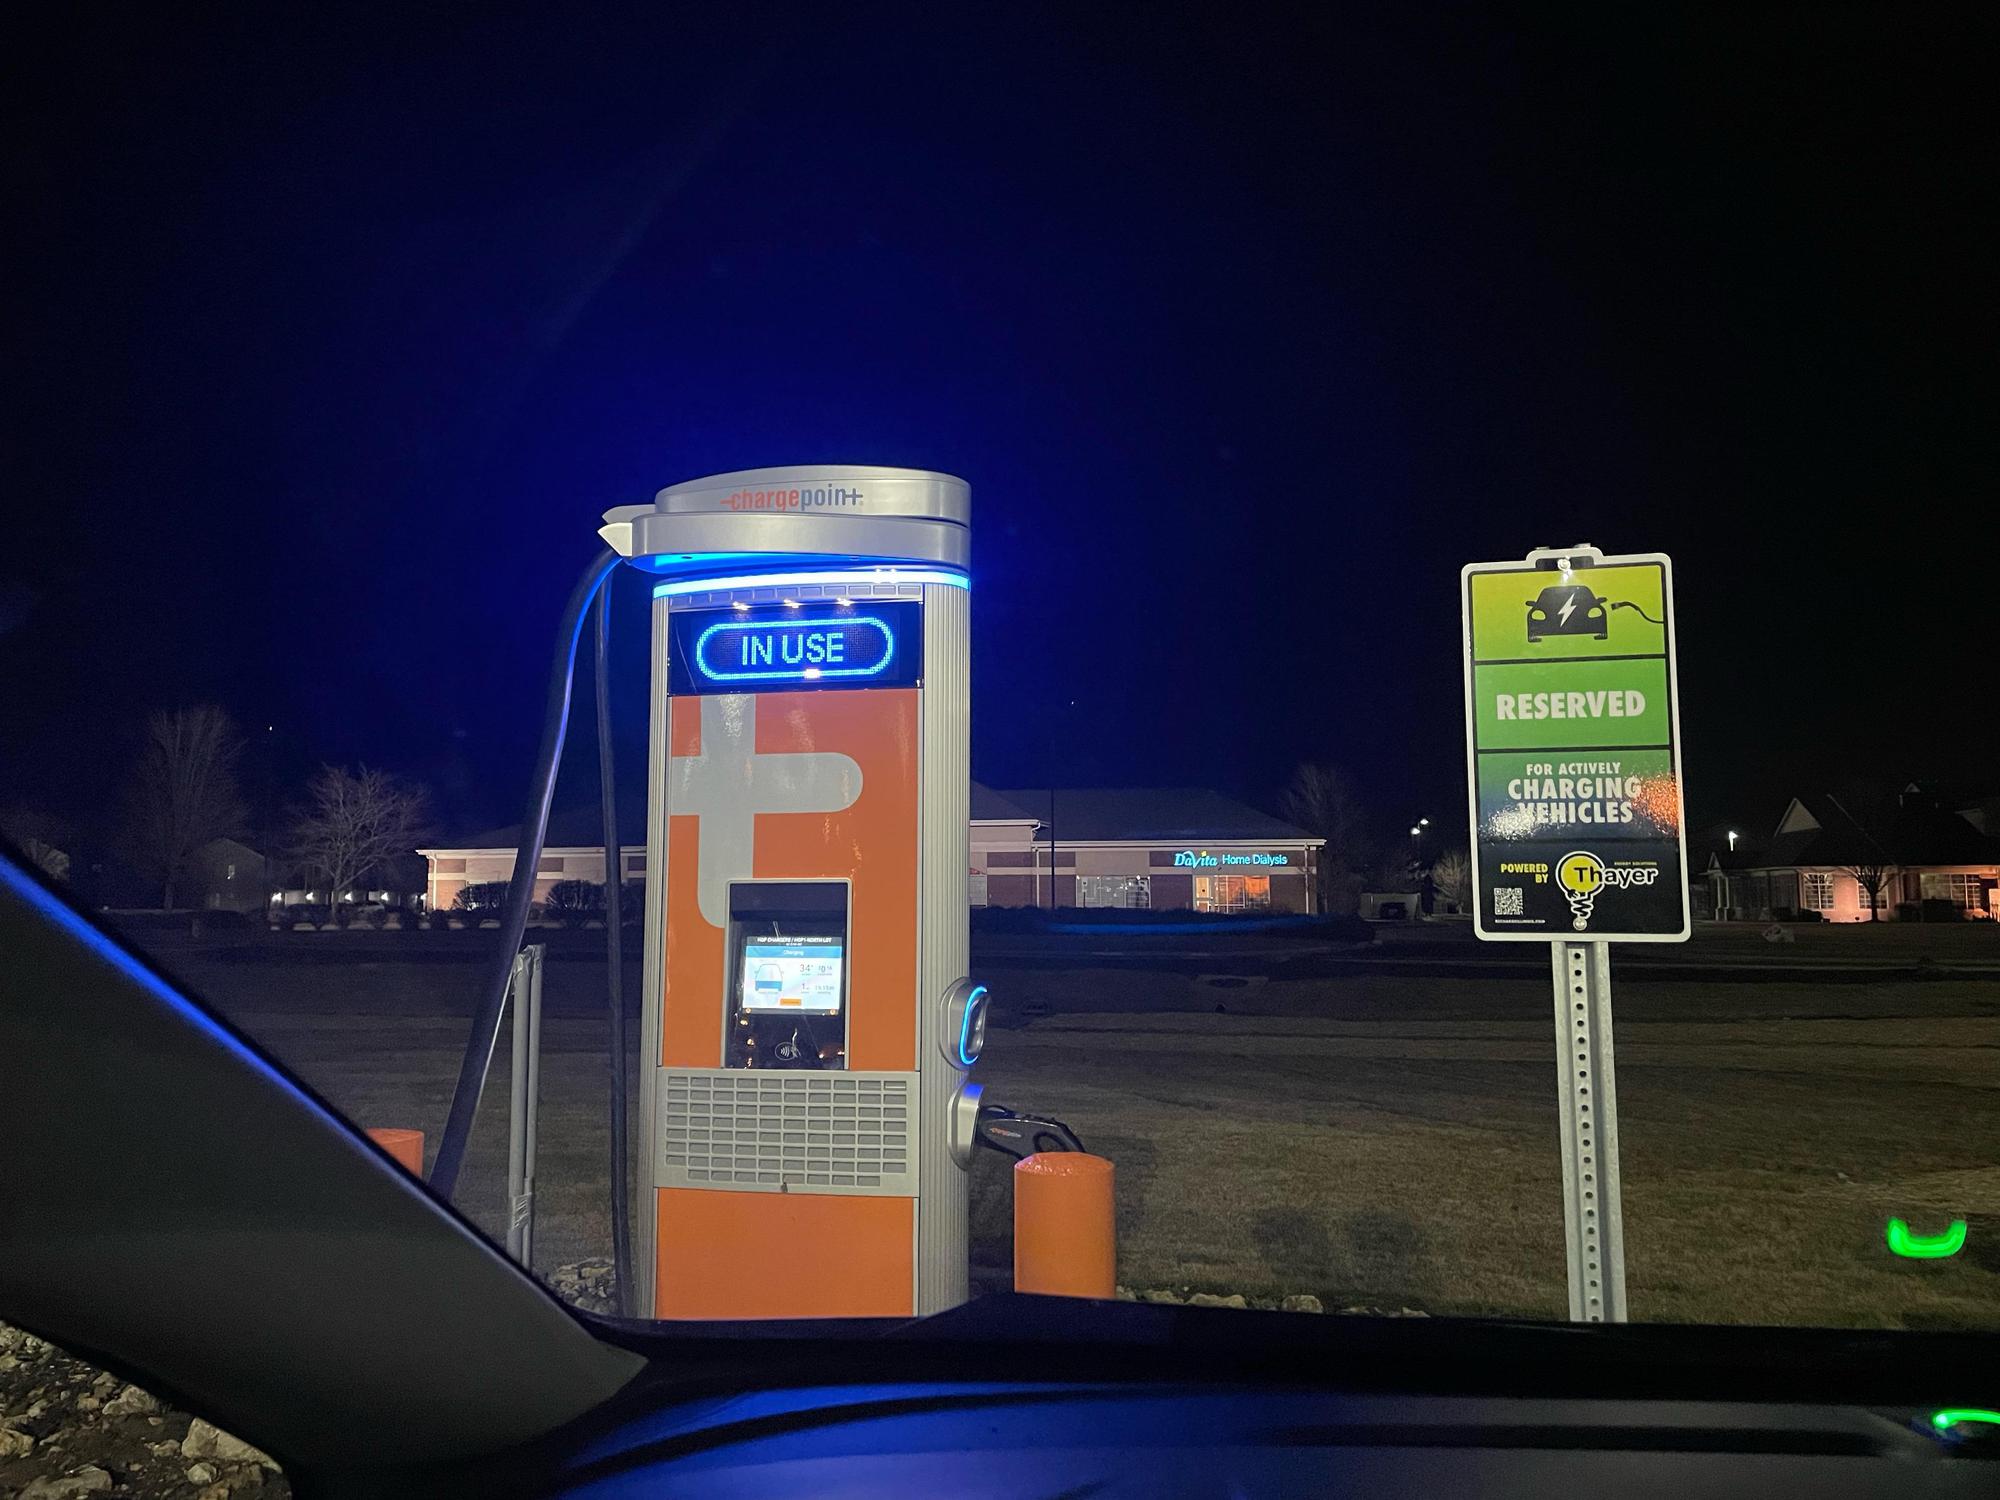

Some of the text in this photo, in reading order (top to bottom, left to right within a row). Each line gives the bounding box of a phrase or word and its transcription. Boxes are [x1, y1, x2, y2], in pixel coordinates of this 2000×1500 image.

[742, 632, 844, 665] IN USE
[1496, 690, 1646, 720] RESERVED
[1526, 761, 1621, 776] FOR ACTIVELY
[1507, 775, 1642, 801] CHARGING
[1518, 799, 1634, 825] VEHICLES
[1174, 850, 1288, 868] DaVita Home Dialysis
[1500, 863, 1549, 873] POWERED
[1535, 874, 1549, 884] BY
[1573, 866, 1659, 889] Thayer
